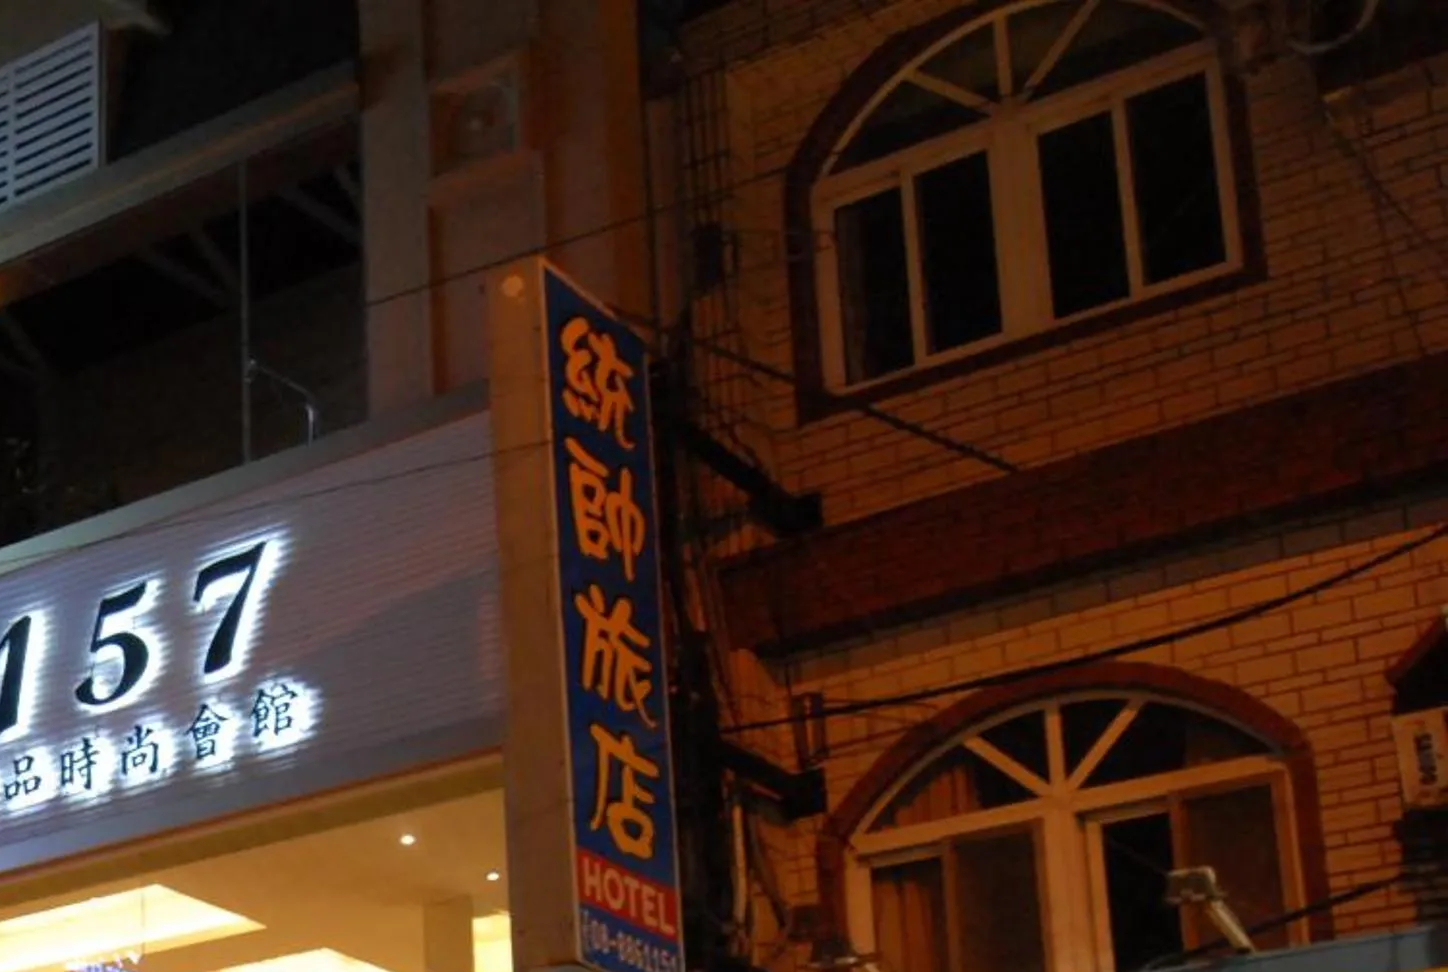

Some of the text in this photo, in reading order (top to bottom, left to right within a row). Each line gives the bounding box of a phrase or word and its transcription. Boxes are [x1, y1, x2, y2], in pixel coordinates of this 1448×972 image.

[560, 317, 659, 861] 統帥旅店
[582, 856, 676, 937] HOTEL
